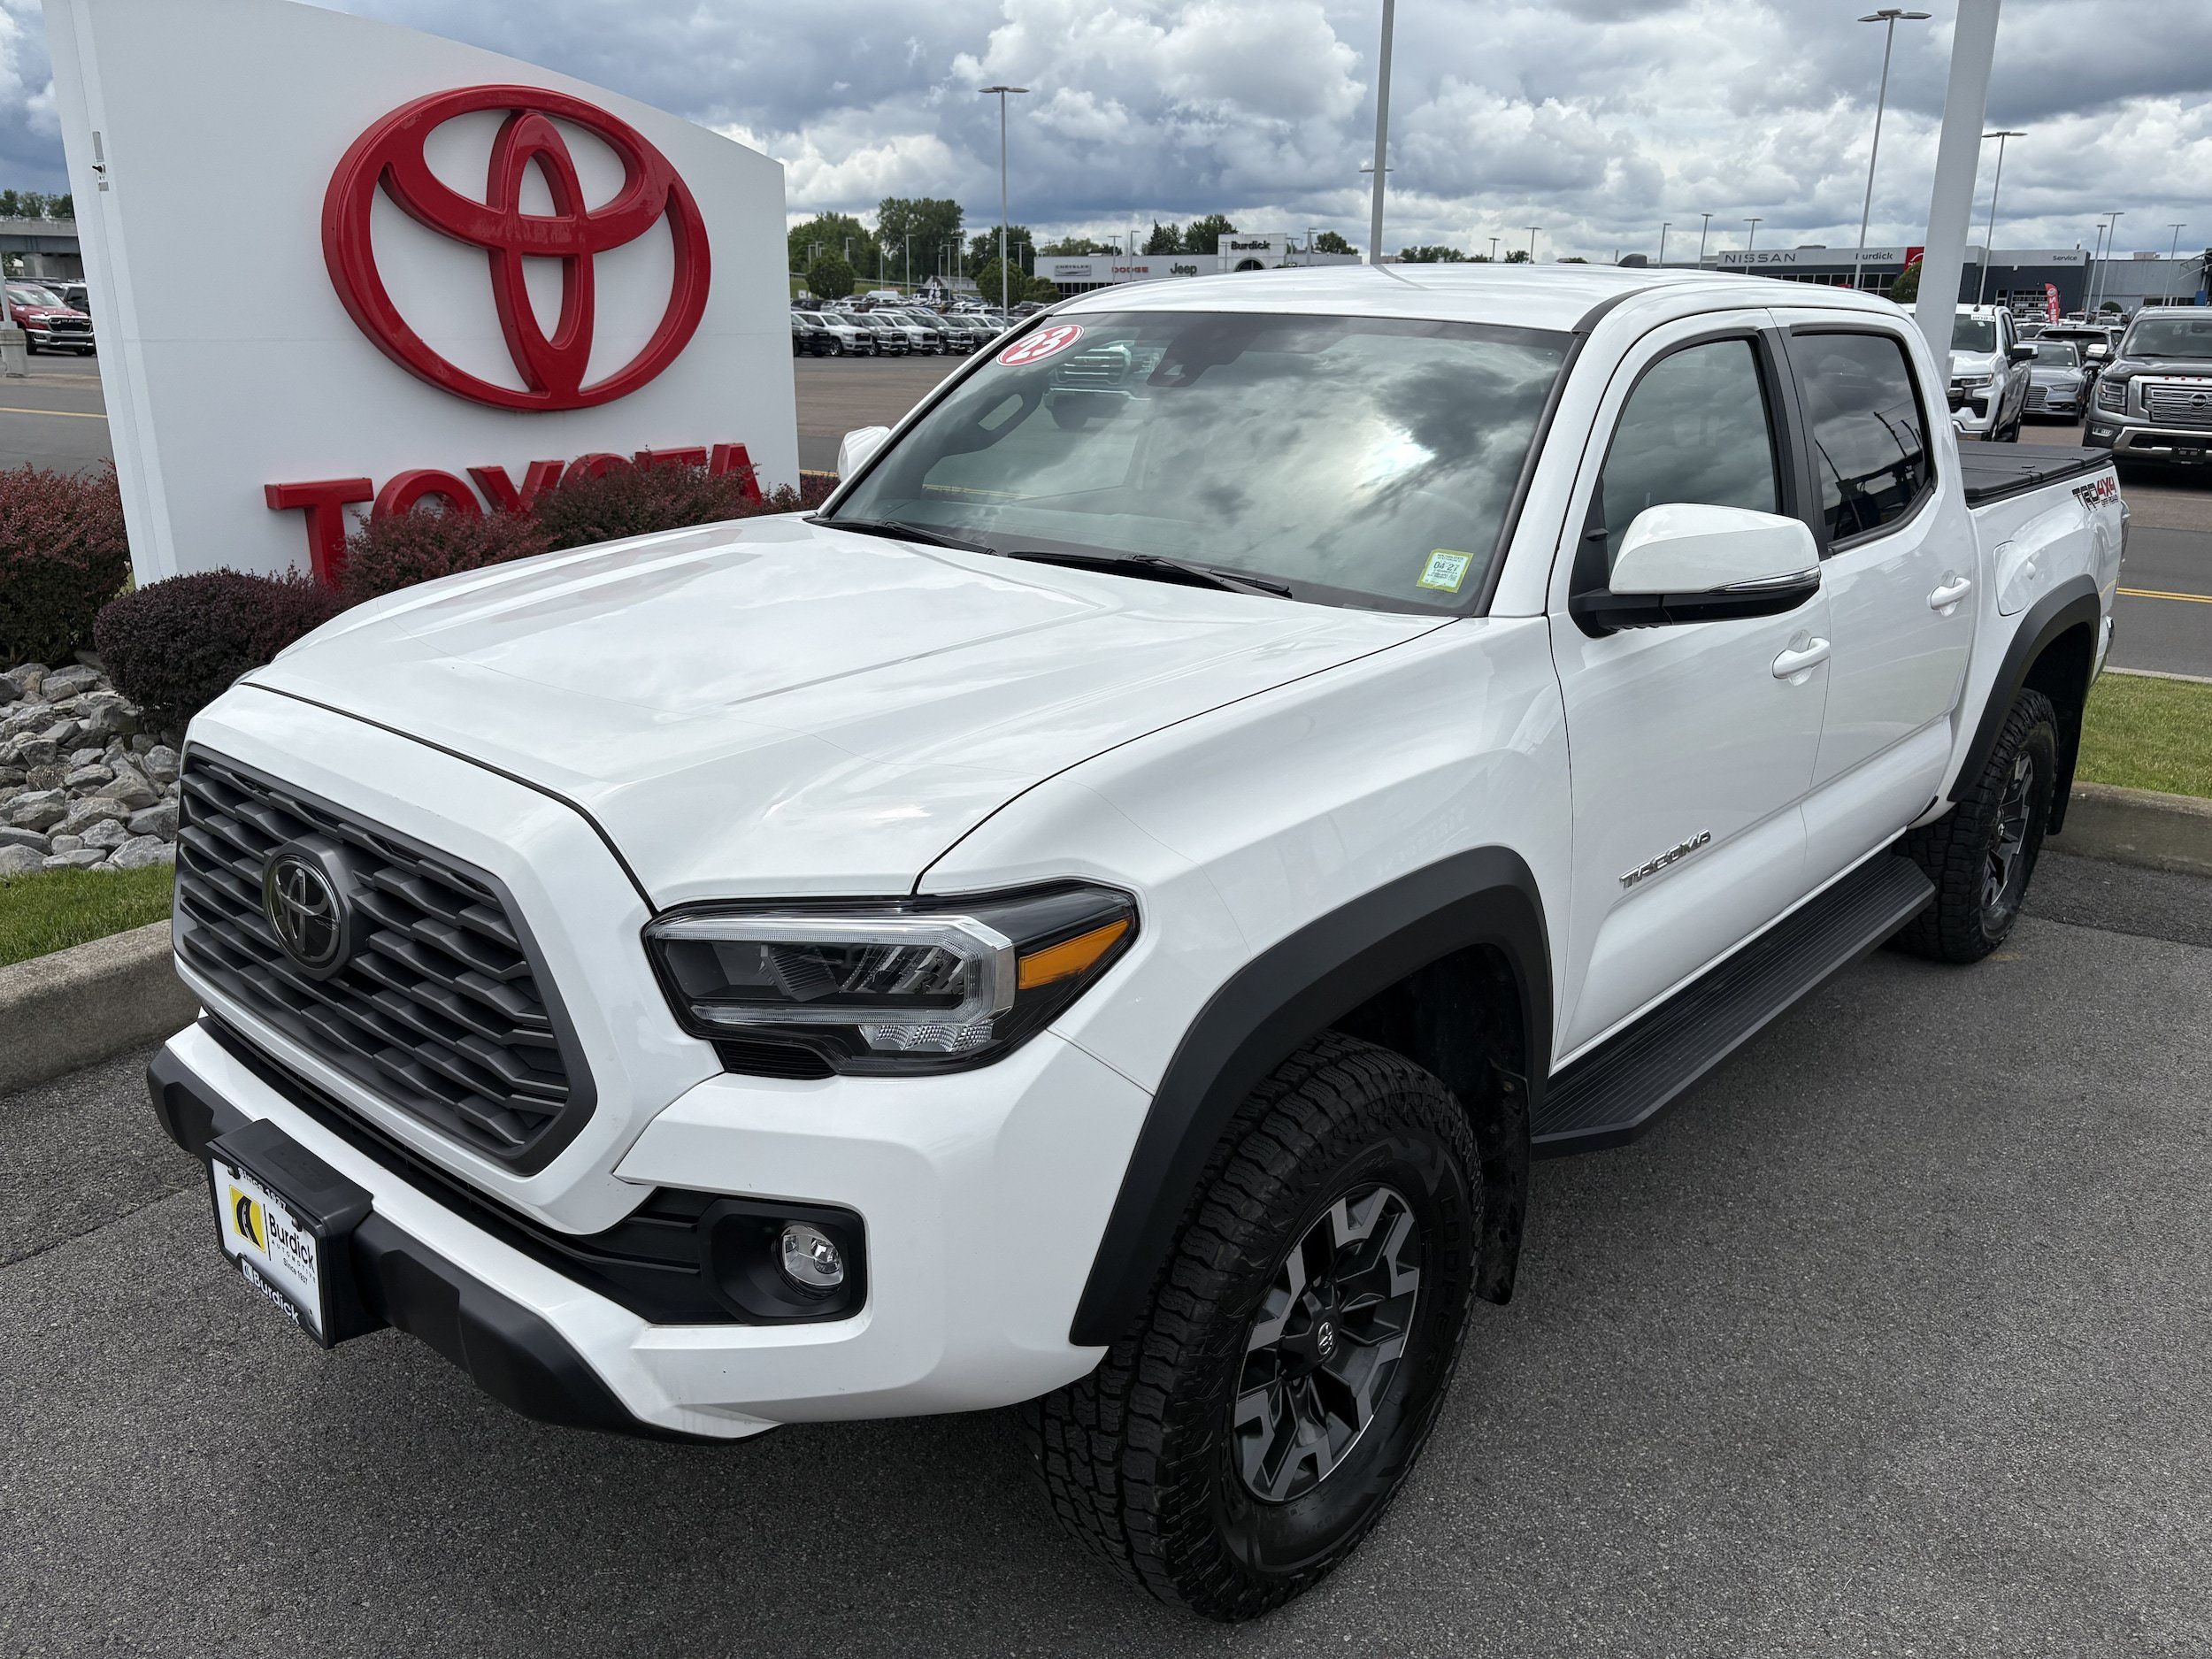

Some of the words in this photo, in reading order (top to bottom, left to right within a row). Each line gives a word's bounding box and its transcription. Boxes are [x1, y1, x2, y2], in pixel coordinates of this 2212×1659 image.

[1231, 240, 1271, 250] Burdick
[1724, 253, 1796, 263] NISSAN
[1855, 251, 1893, 260] urdick
[1170, 262, 1197, 277] Jeep
[1006, 326, 1073, 363] 23
[265, 442, 763, 591] TOYA
[1619, 828, 1712, 888] TACOMA
[268, 1212, 316, 1274] Burdick
[271, 1240, 317, 1284] AUTOMOTIVE
[282, 1257, 297, 1276] Since
[297, 1271, 309, 1286] 1937
[253, 1271, 301, 1326] Burdick
